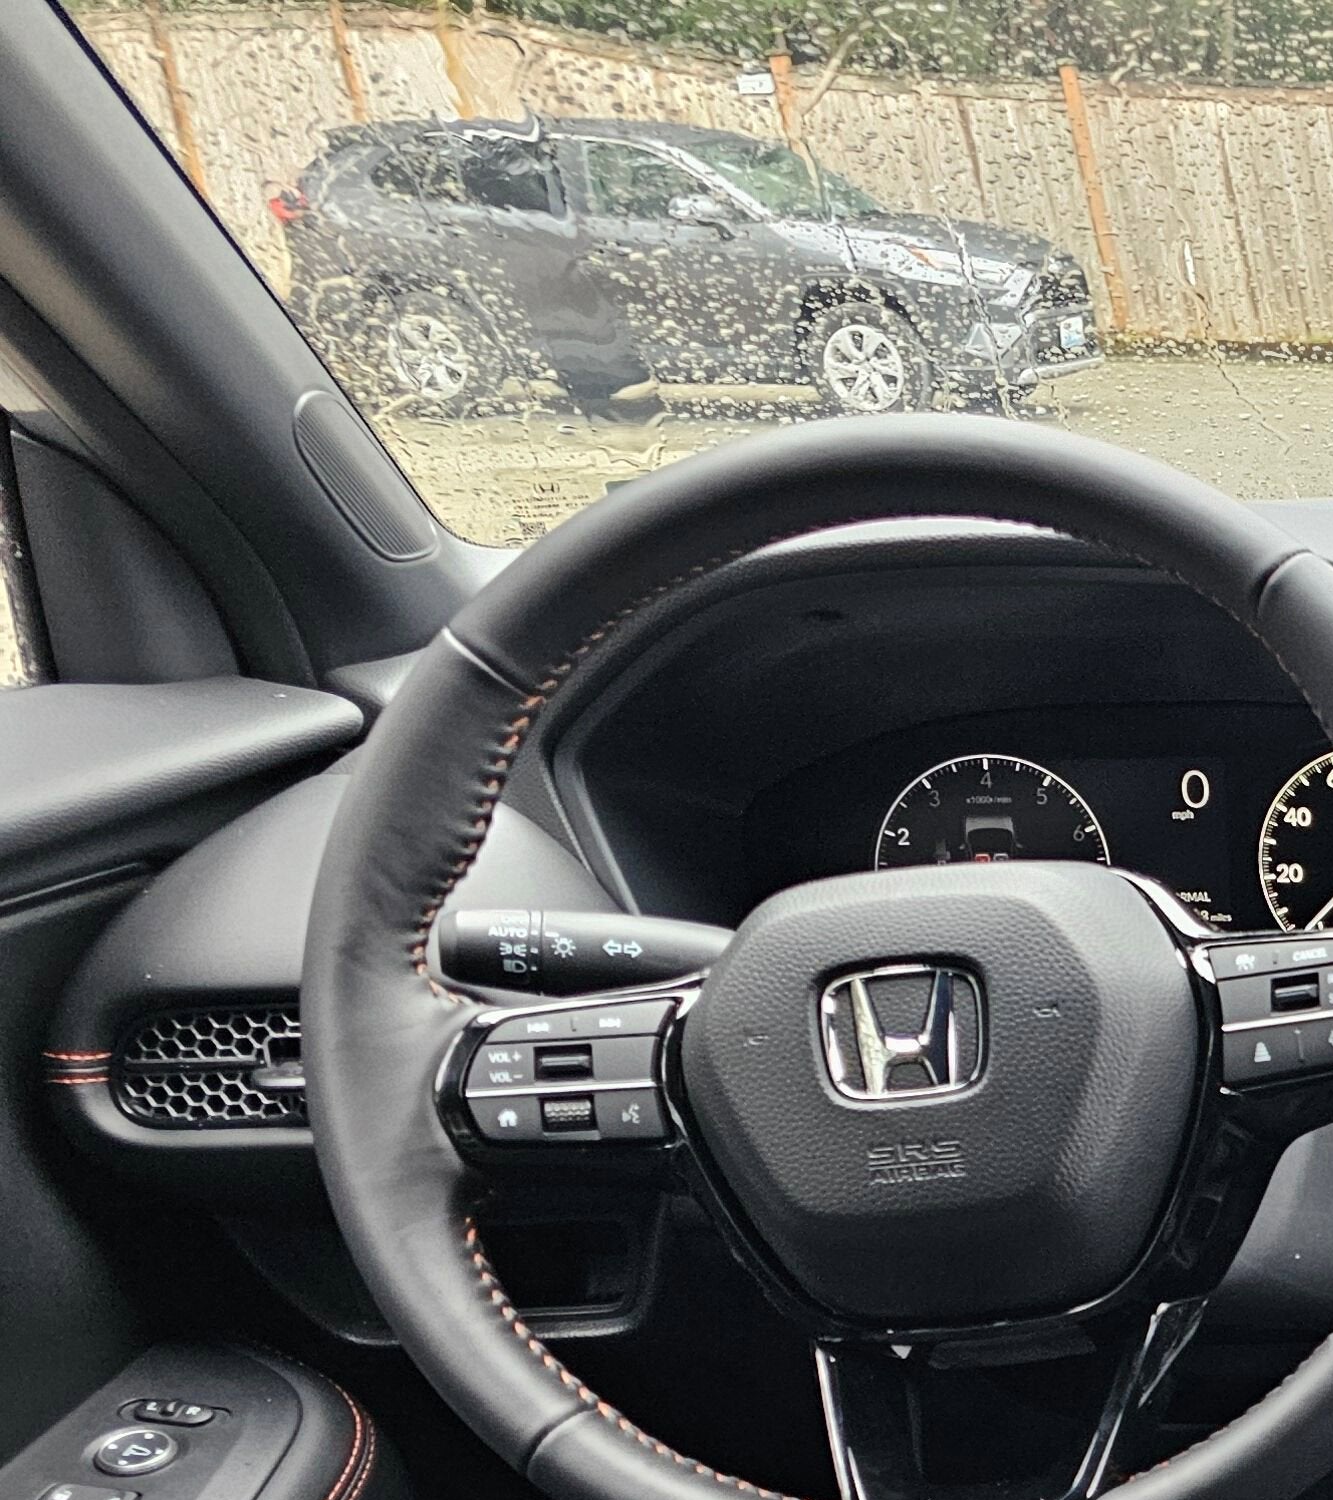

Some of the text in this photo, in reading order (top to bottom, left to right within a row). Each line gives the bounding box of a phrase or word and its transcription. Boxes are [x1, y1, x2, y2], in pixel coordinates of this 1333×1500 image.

[980, 772, 993, 789] 4
[928, 790, 941, 807] 3
[1036, 787, 1048, 805] 5
[1171, 809, 1195, 821] mph
[1283, 806, 1312, 828] 40
[897, 828, 910, 846] 2
[1073, 824, 1085, 842] 6
[1276, 862, 1304, 883] 20
[1176, 891, 1212, 903] RMAL
[488, 926, 528, 938] AUTO
[867, 1140, 961, 1163] SRS
